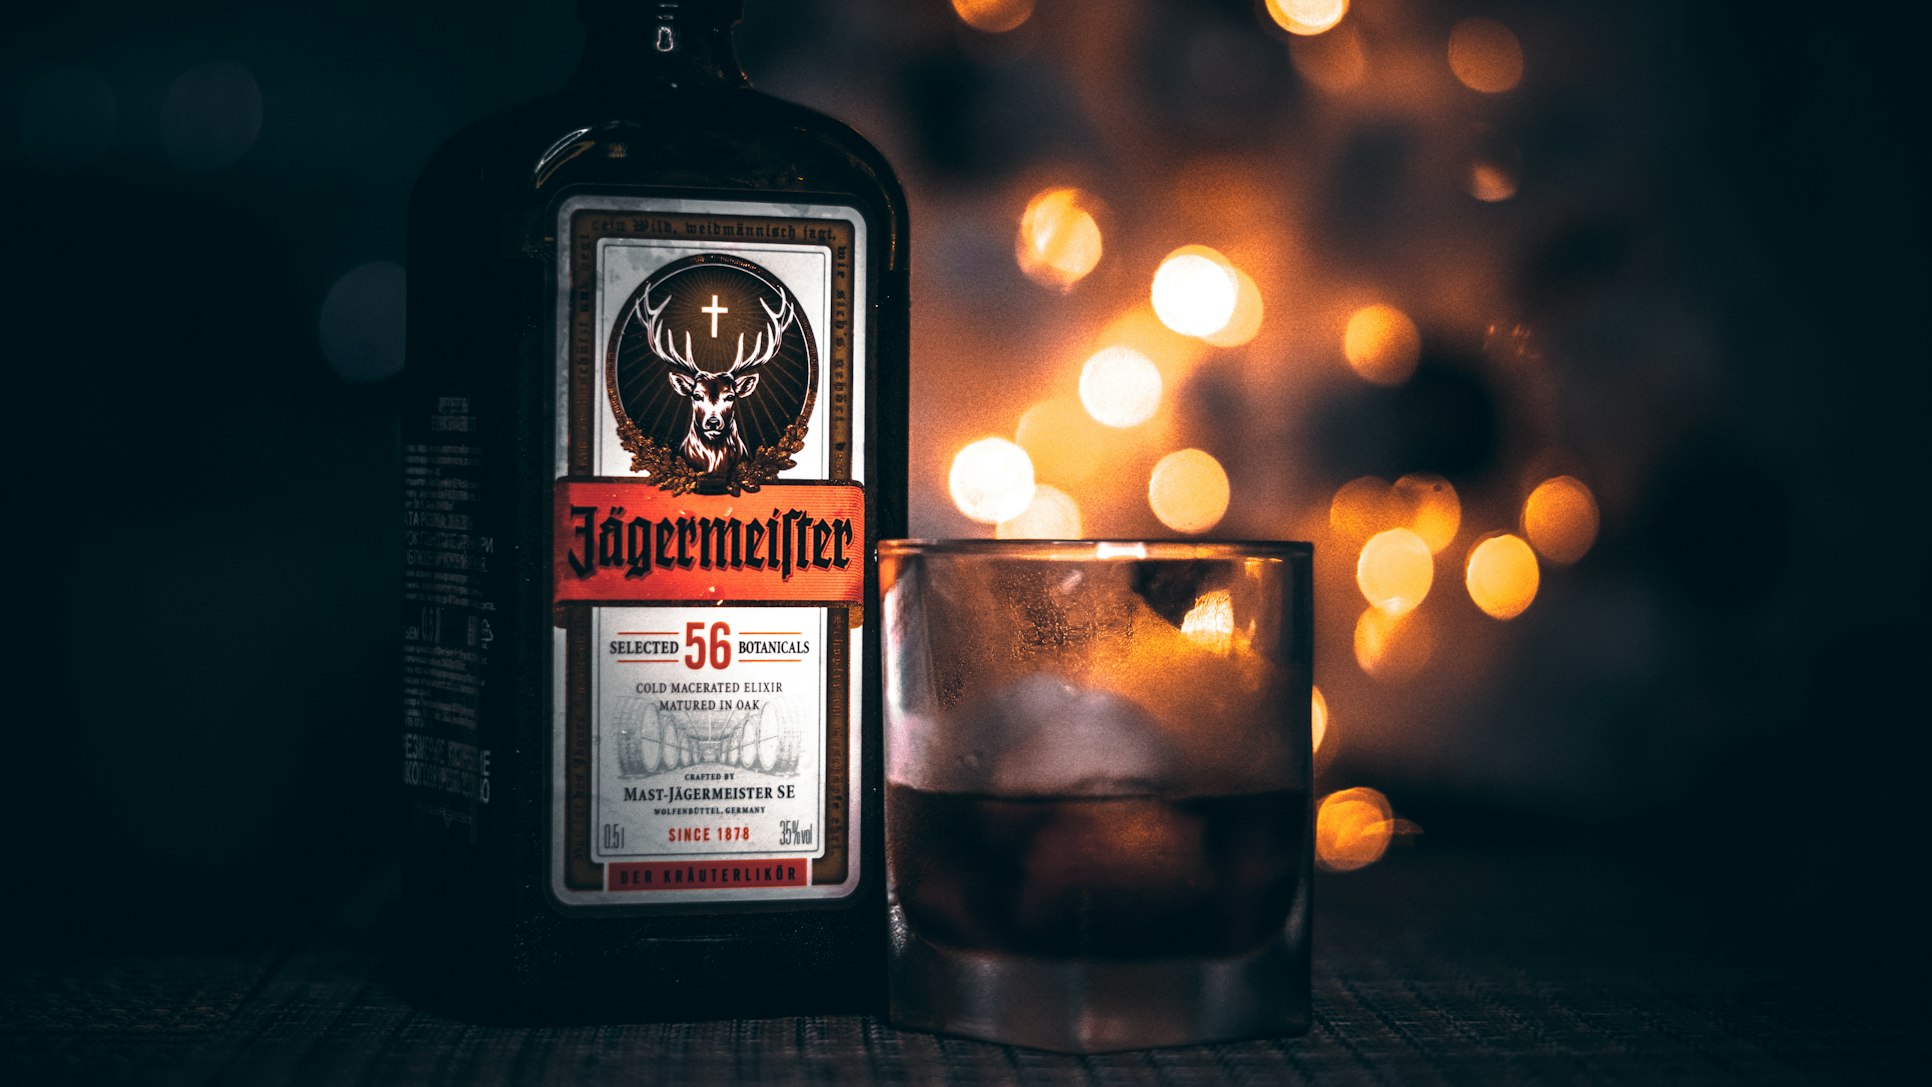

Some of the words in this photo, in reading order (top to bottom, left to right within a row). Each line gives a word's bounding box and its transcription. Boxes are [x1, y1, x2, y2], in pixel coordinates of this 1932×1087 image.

[610, 640, 679, 655] SELECTED
[684, 622, 732, 670] 56
[738, 640, 810, 655] BOTANICALS
[636, 682, 668, 694] COLD
[671, 682, 740, 694] MACERATED
[744, 682, 783, 694] ELIXIR
[659, 699, 717, 712] MATURED
[719, 699, 733, 711] IN
[736, 699, 760, 711] OAK
[684, 772, 721, 782] CRAFTED
[723, 772, 735, 781] BY
[623, 783, 772, 802] MAST-JÄGERMEISTER
[777, 785, 796, 800] SE
[654, 805, 724, 817] WOLFENBÜTTEL,
[725, 806, 766, 815] GERMANY
[668, 827, 711, 843] SINCE
[717, 827, 751, 842] 1878
[620, 868, 653, 885] DER
[664, 863, 797, 883] KRÄUTERLIKÖR
